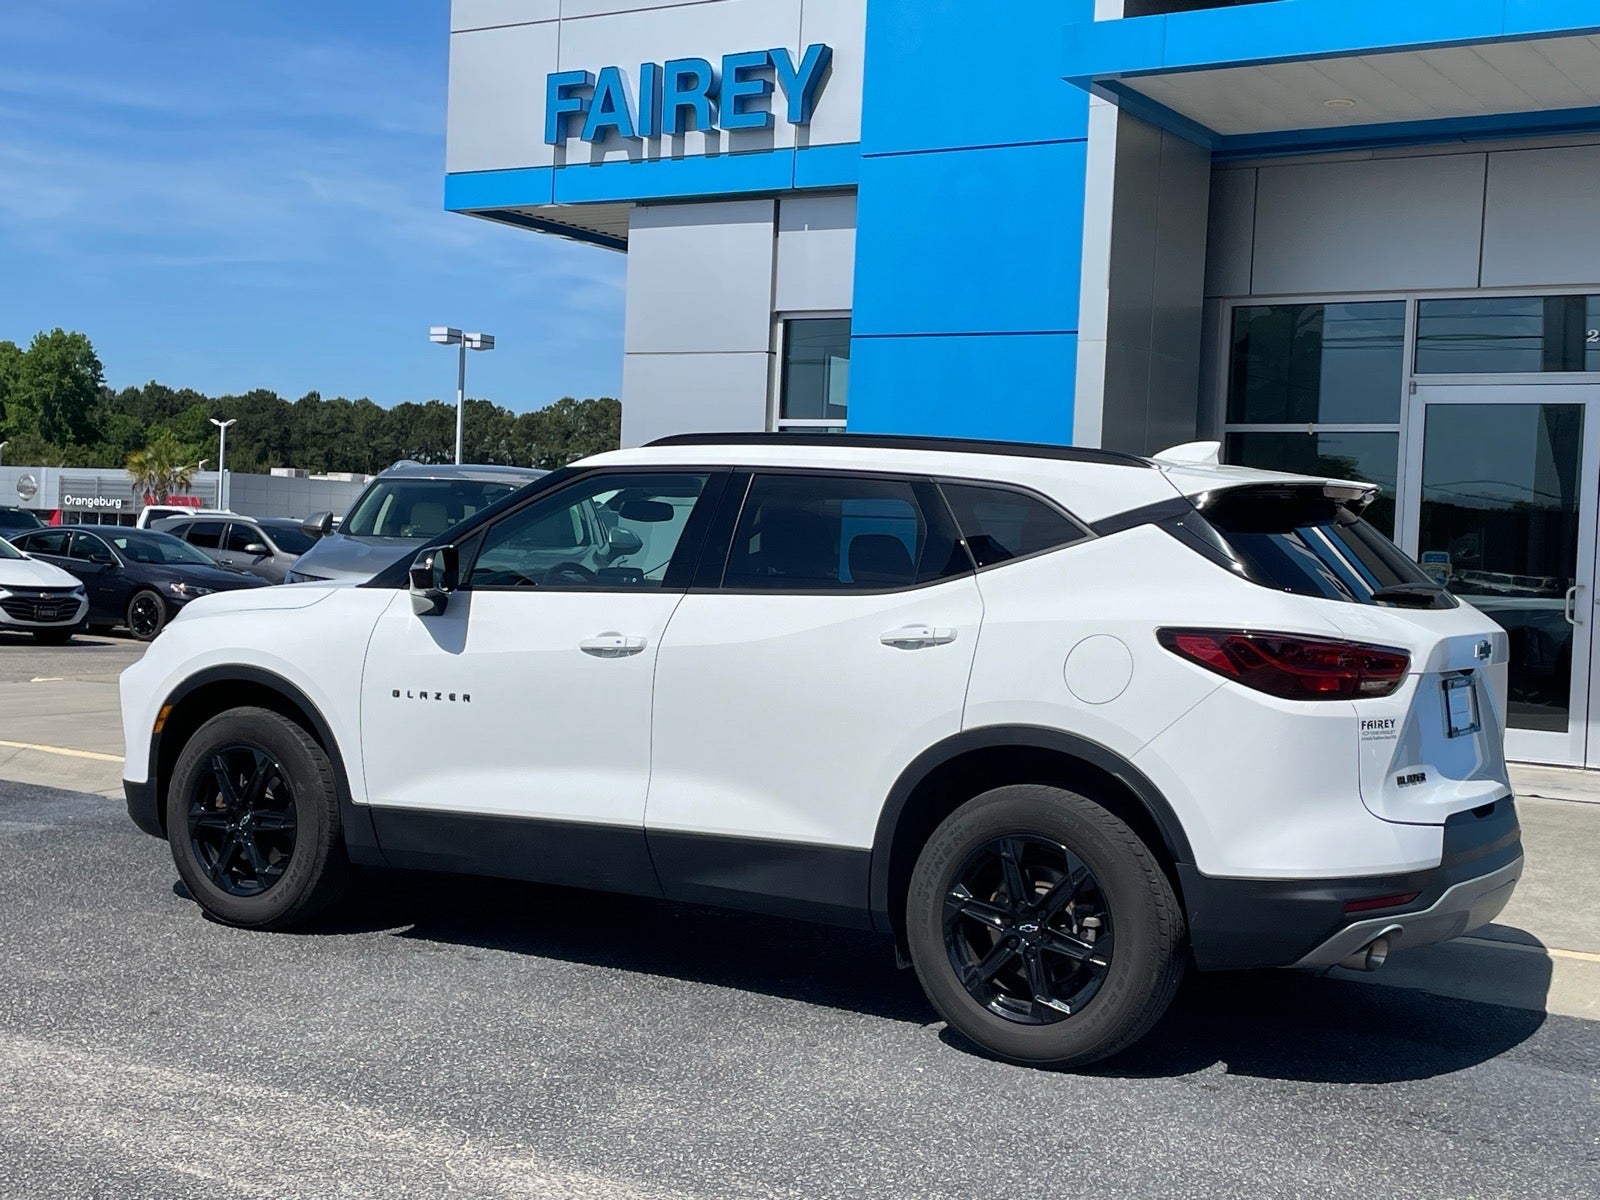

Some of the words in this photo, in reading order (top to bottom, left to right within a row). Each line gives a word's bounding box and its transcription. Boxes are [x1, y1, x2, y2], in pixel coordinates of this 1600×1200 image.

[544, 43, 833, 147] FAIREY
[64, 494, 122, 509] Orangeburg
[392, 689, 471, 703] BLAZER
[1361, 719, 1396, 730] FAIREY
[1396, 772, 1427, 786] BLAZER
